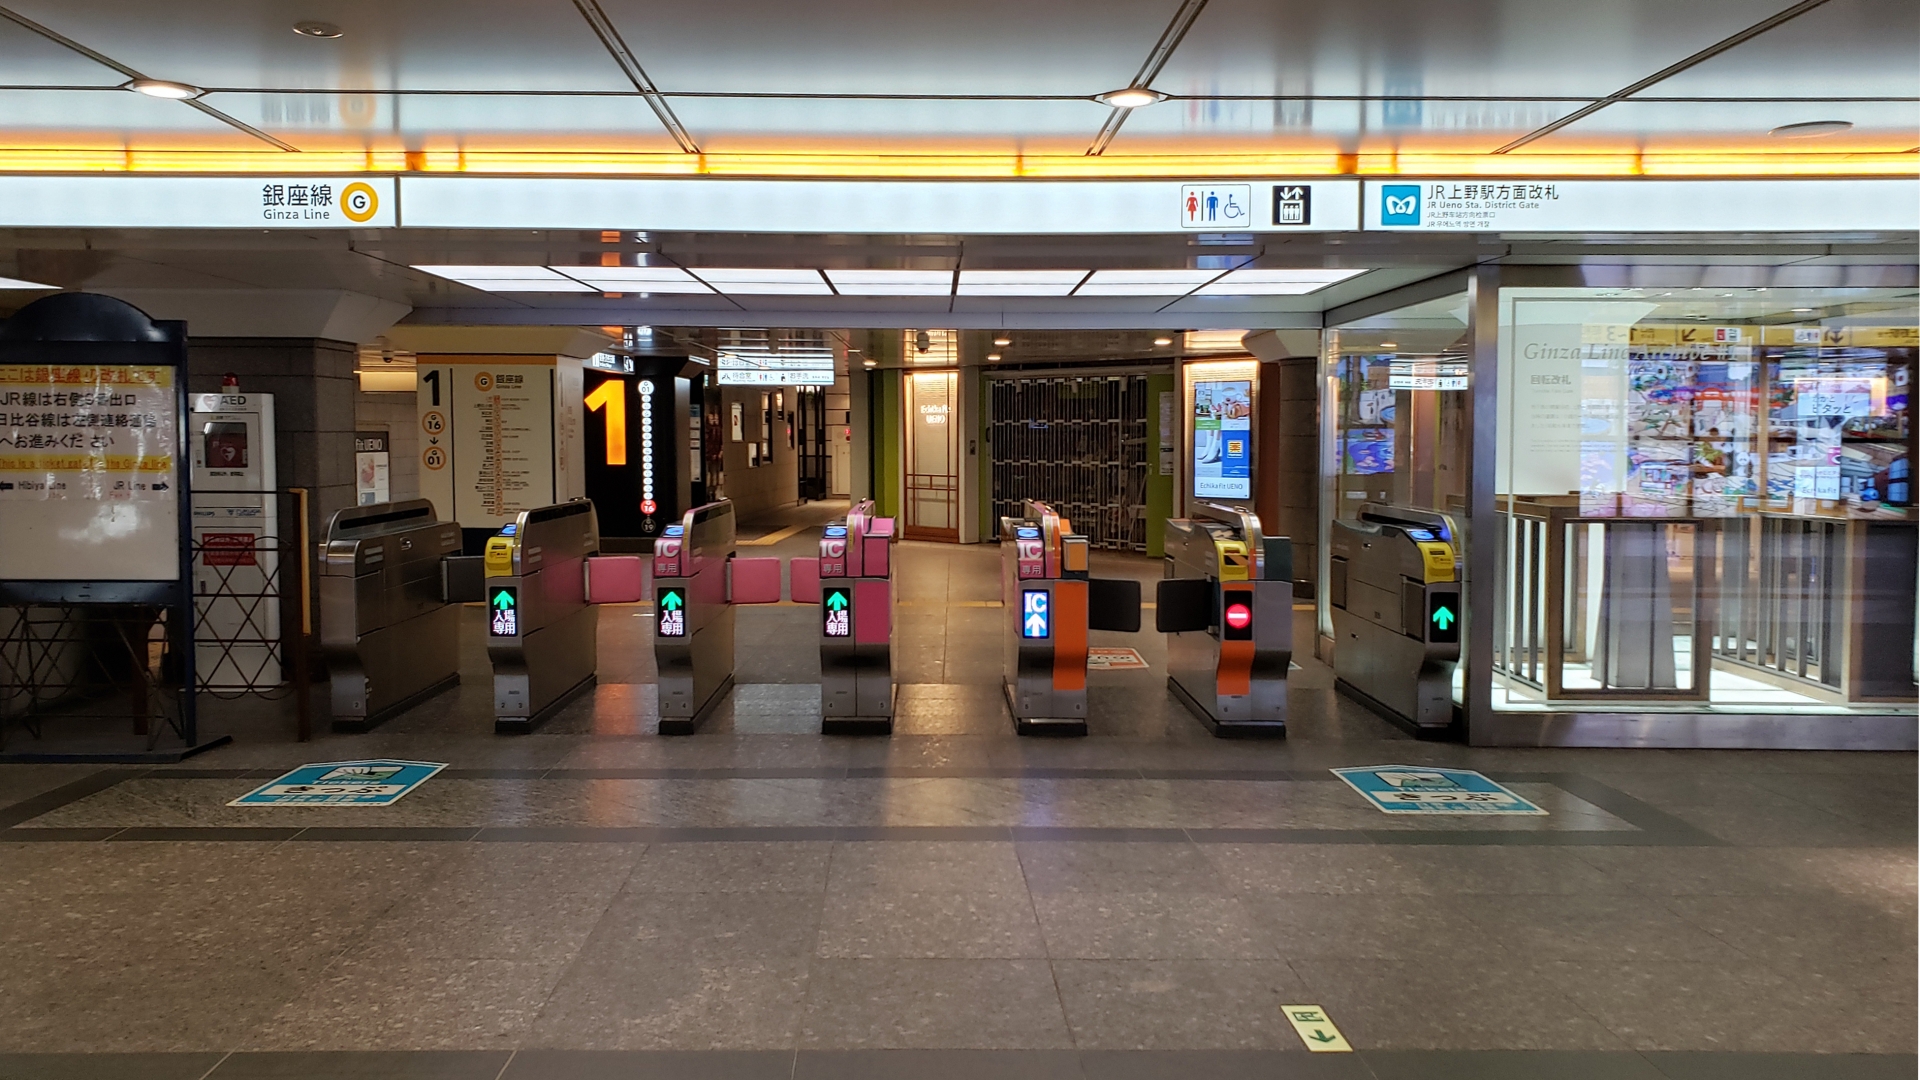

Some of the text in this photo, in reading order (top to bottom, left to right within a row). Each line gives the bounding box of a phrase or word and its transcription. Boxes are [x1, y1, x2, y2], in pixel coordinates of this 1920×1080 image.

[262, 184, 333, 207] 銀座線
[1427, 184, 1559, 200] JR上野駅方面改札
[353, 195, 366, 209] G
[1427, 201, 1540, 209] JR Ueno Sta. District Gate
[263, 209, 330, 220] Ginza Line
[1523, 343, 1581, 360] Ginza
[1587, 343, 1630, 360] Line
[423, 370, 440, 406] 1
[221, 396, 247, 405] AED
[428, 420, 441, 430] 16
[584, 380, 627, 465] 1
[427, 456, 440, 465] 01
[18, 481, 45, 491] Hibiya
[655, 540, 680, 557] IC
[820, 541, 844, 558] IC
[1017, 542, 1042, 559] IC
[658, 563, 677, 573] 専用
[823, 563, 842, 573] 専用
[1022, 565, 1041, 575] 専用
[1025, 593, 1047, 613] IC
[493, 609, 516, 622] 入場
[661, 610, 683, 623] 入場
[826, 610, 848, 623] 入場
[493, 622, 516, 634] 専用
[660, 623, 683, 635] 専用
[826, 623, 848, 635] 専用
